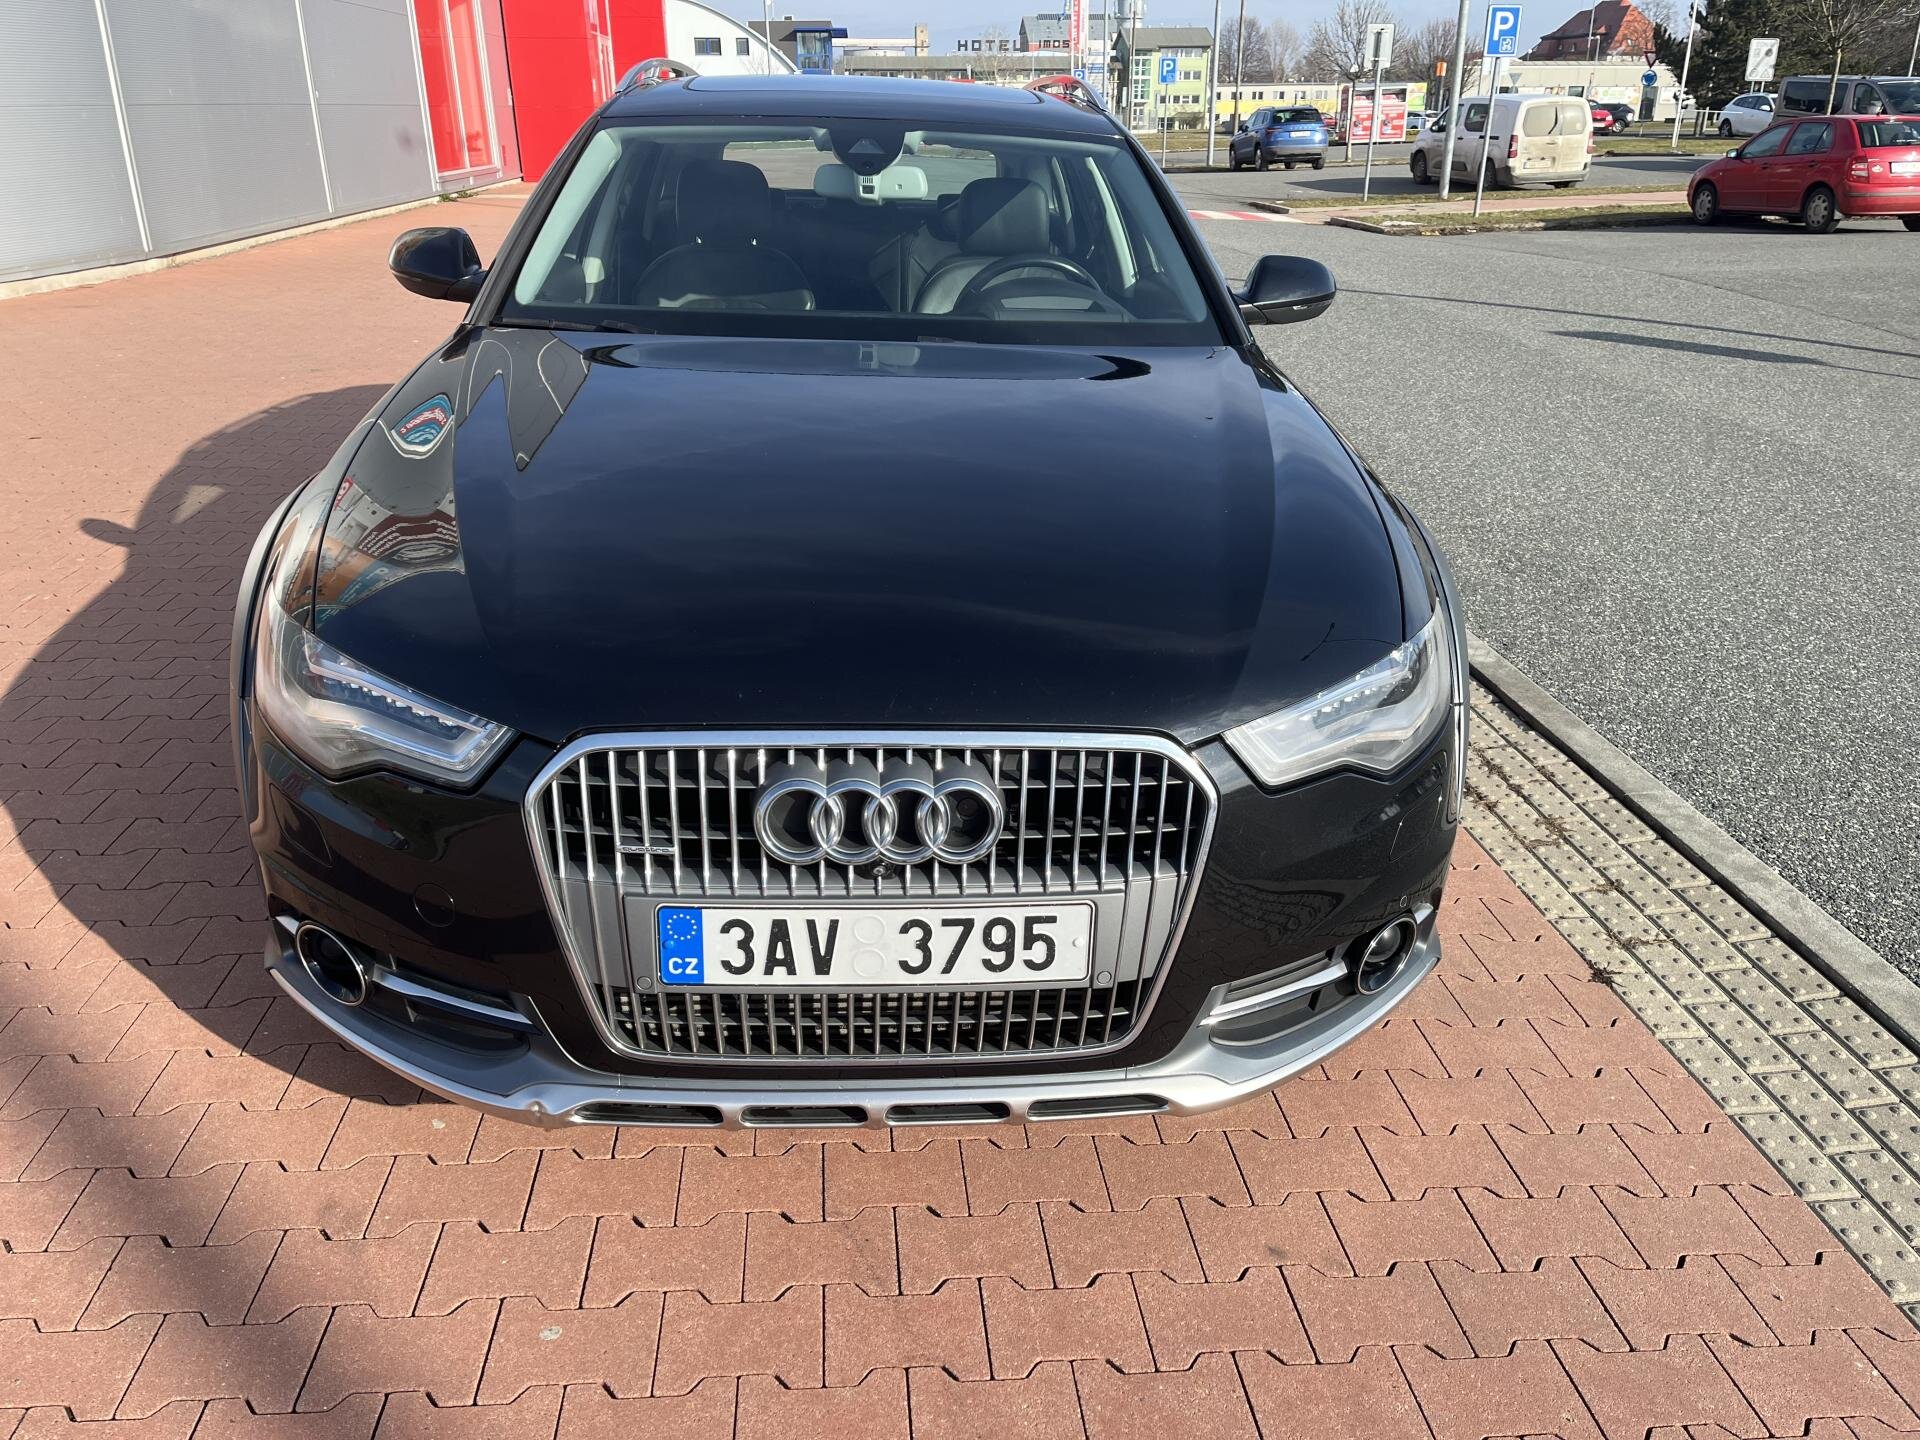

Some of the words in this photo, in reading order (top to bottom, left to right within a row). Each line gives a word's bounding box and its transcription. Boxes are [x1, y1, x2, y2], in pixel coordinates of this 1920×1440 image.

[1493, 11, 1514, 41] P
[957, 39, 1021, 52] HOTEL
[1038, 39, 1070, 49] IMOS
[1163, 60, 1174, 76] P
[719, 917, 840, 976] 3AV
[898, 915, 1057, 976] 3795
[668, 959, 698, 975] CZ
